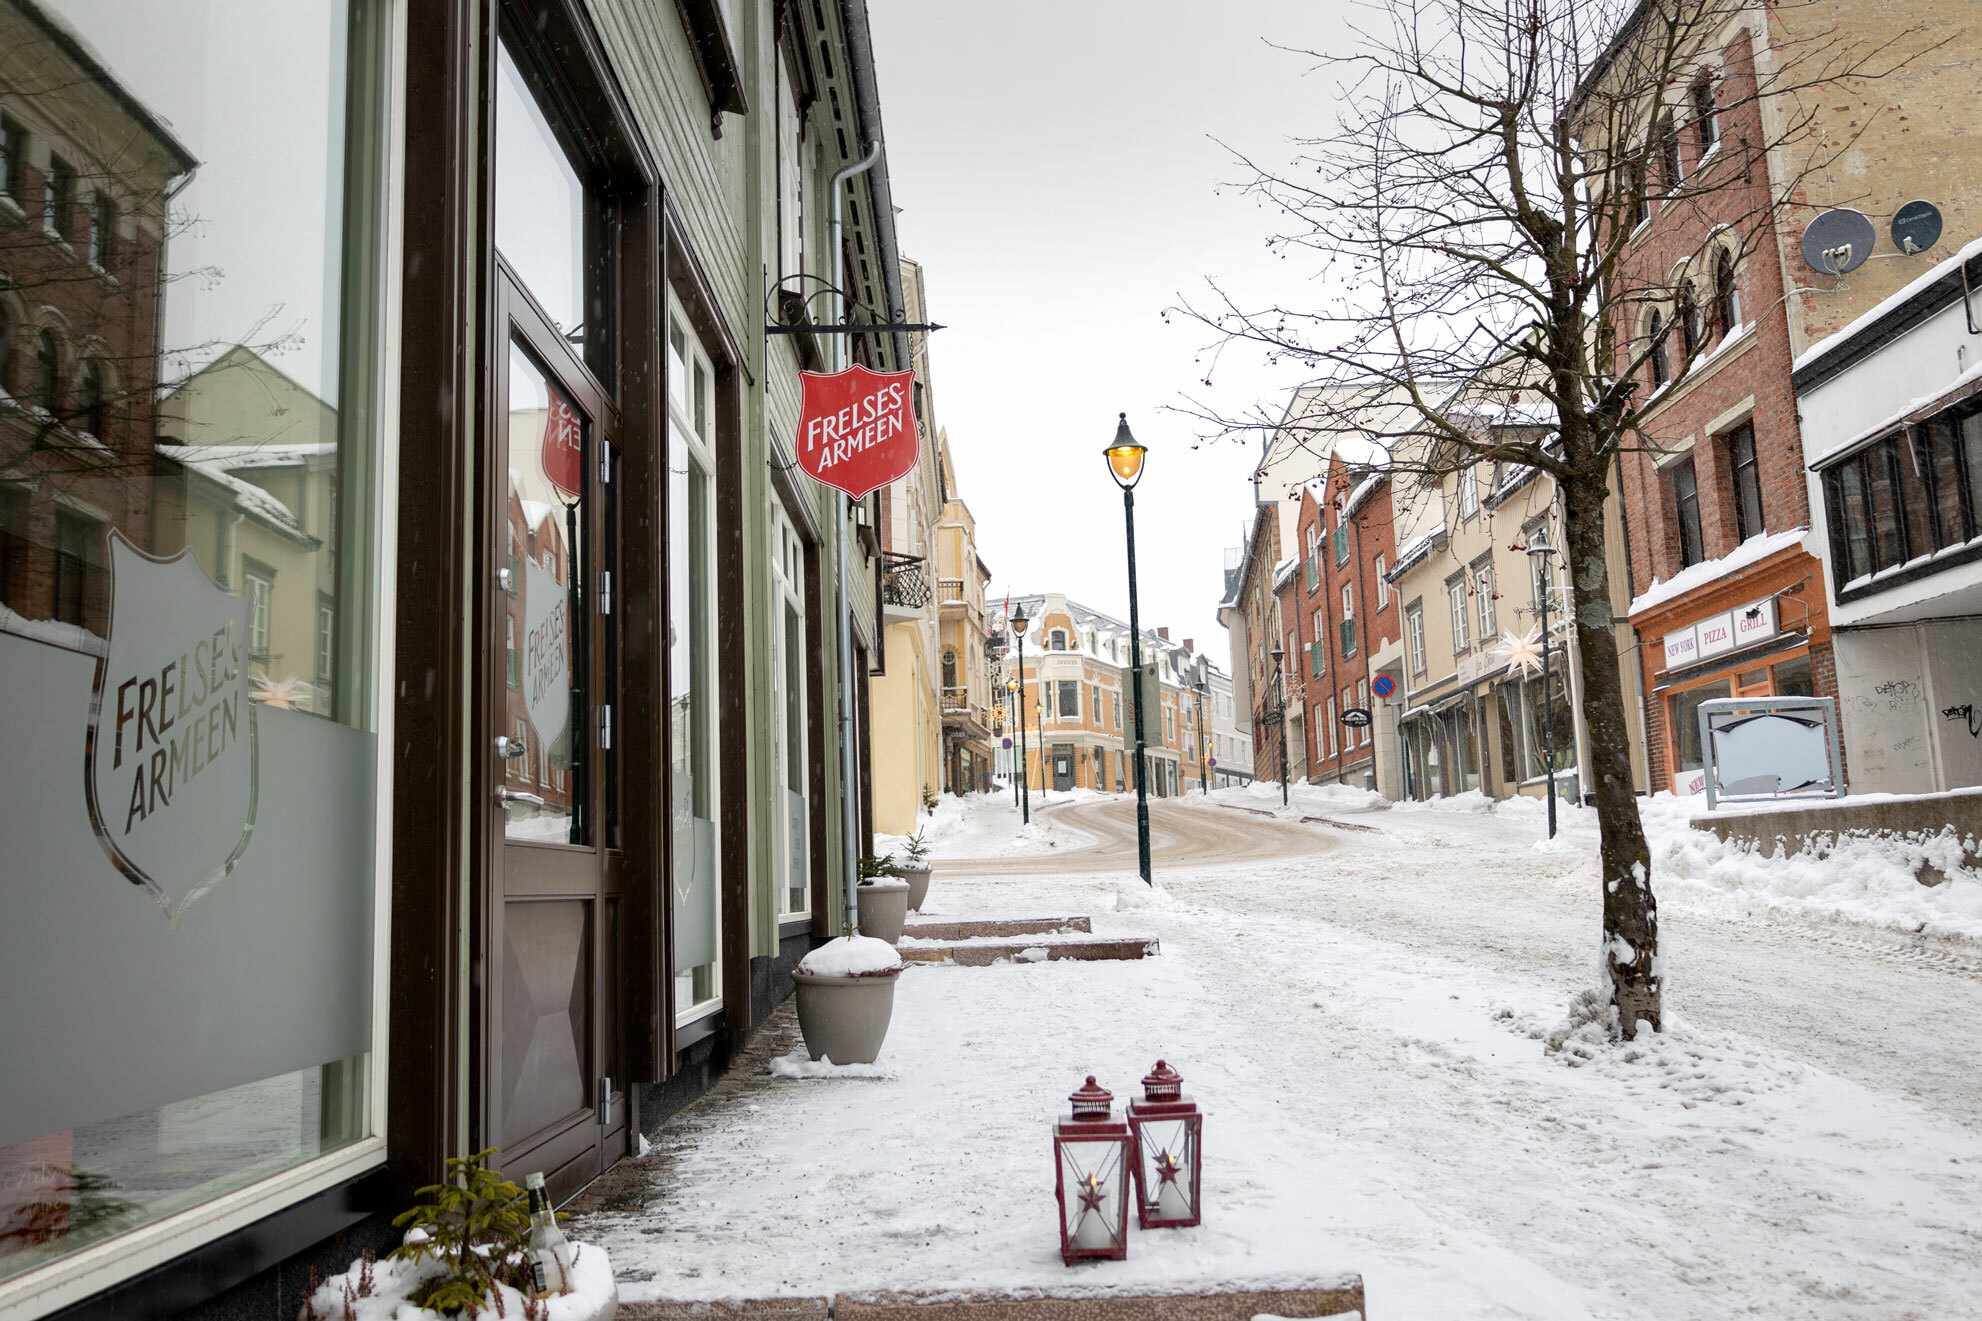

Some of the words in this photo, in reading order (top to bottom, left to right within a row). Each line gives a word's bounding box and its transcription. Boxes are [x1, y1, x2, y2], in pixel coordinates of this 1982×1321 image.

[817, 409, 903, 474] ARMEEN
[1704, 626, 1727, 645] PIZZA
[1740, 612, 1768, 633] GRILL
[1667, 642, 1680, 658] NEW
[1680, 637, 1695, 653] YORK
[532, 637, 564, 711] ARMEEN
[125, 689, 239, 835] ARMEEN
